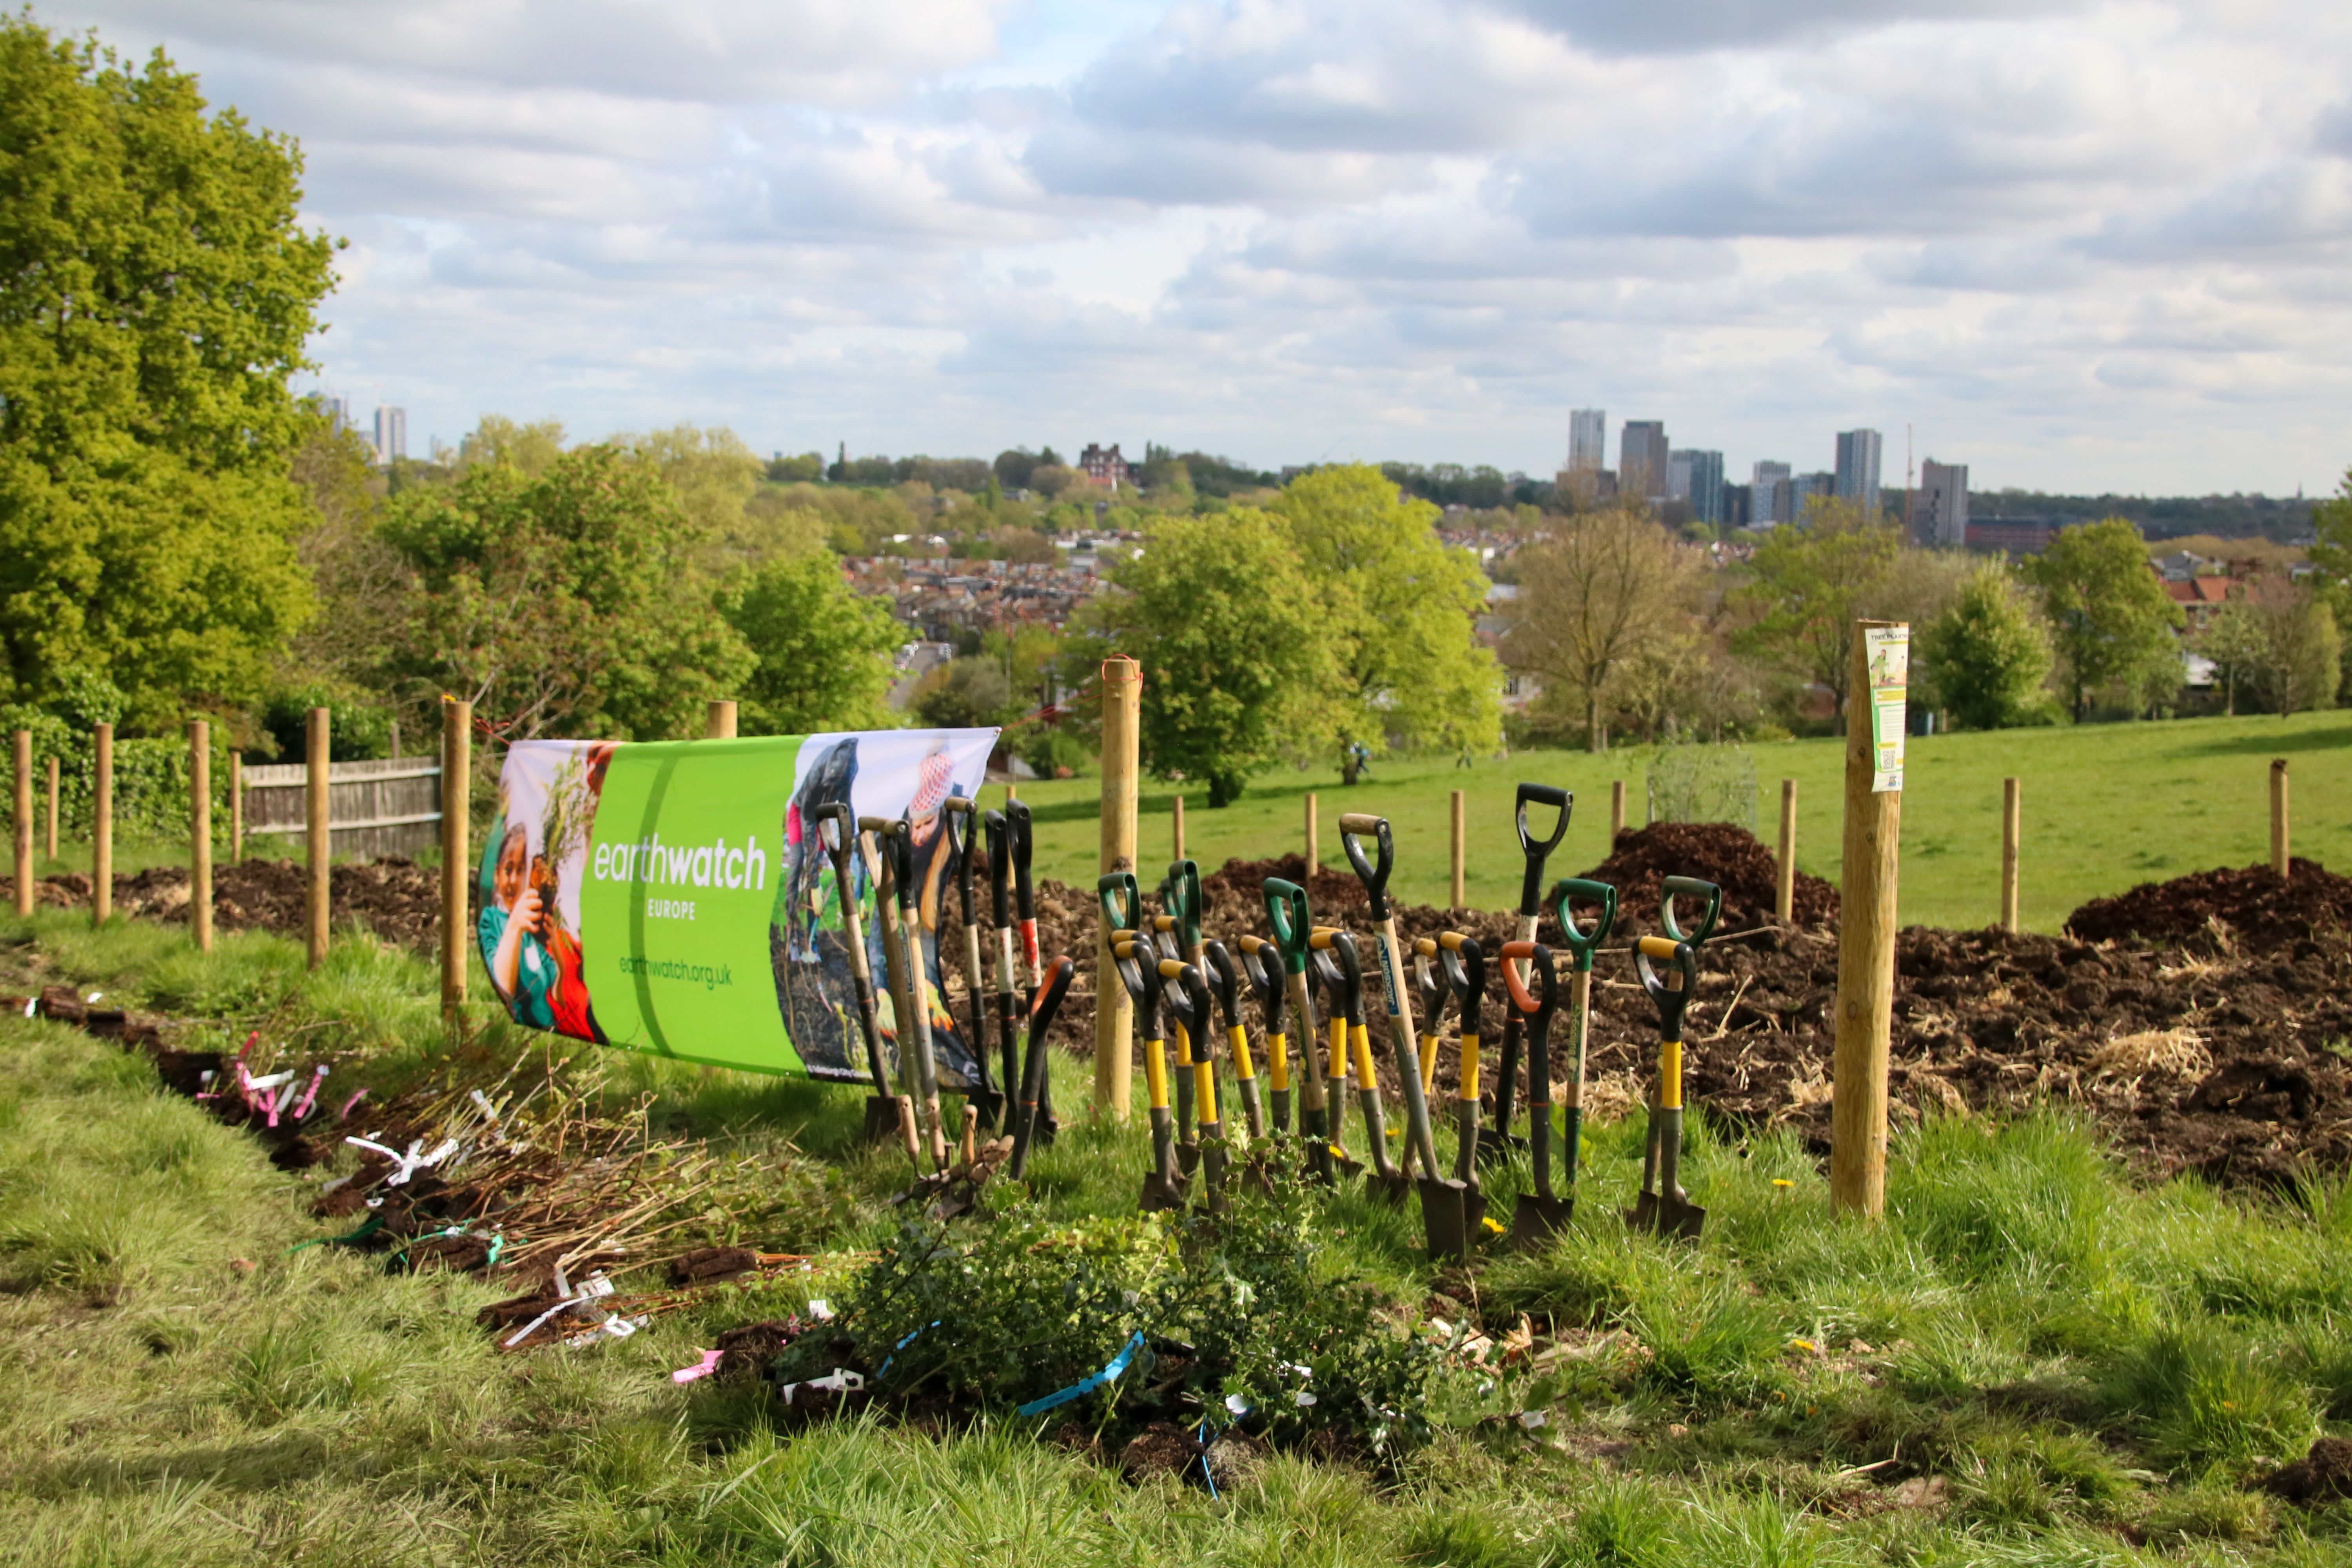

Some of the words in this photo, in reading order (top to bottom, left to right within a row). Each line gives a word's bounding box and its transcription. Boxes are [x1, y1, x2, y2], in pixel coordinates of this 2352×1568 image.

[594, 833, 766, 890] earthwatch
[648, 899, 695, 920] EUROPE
[619, 956, 733, 990] earthwatch.org.uk
[1380, 959, 1396, 1005] JACKSON
